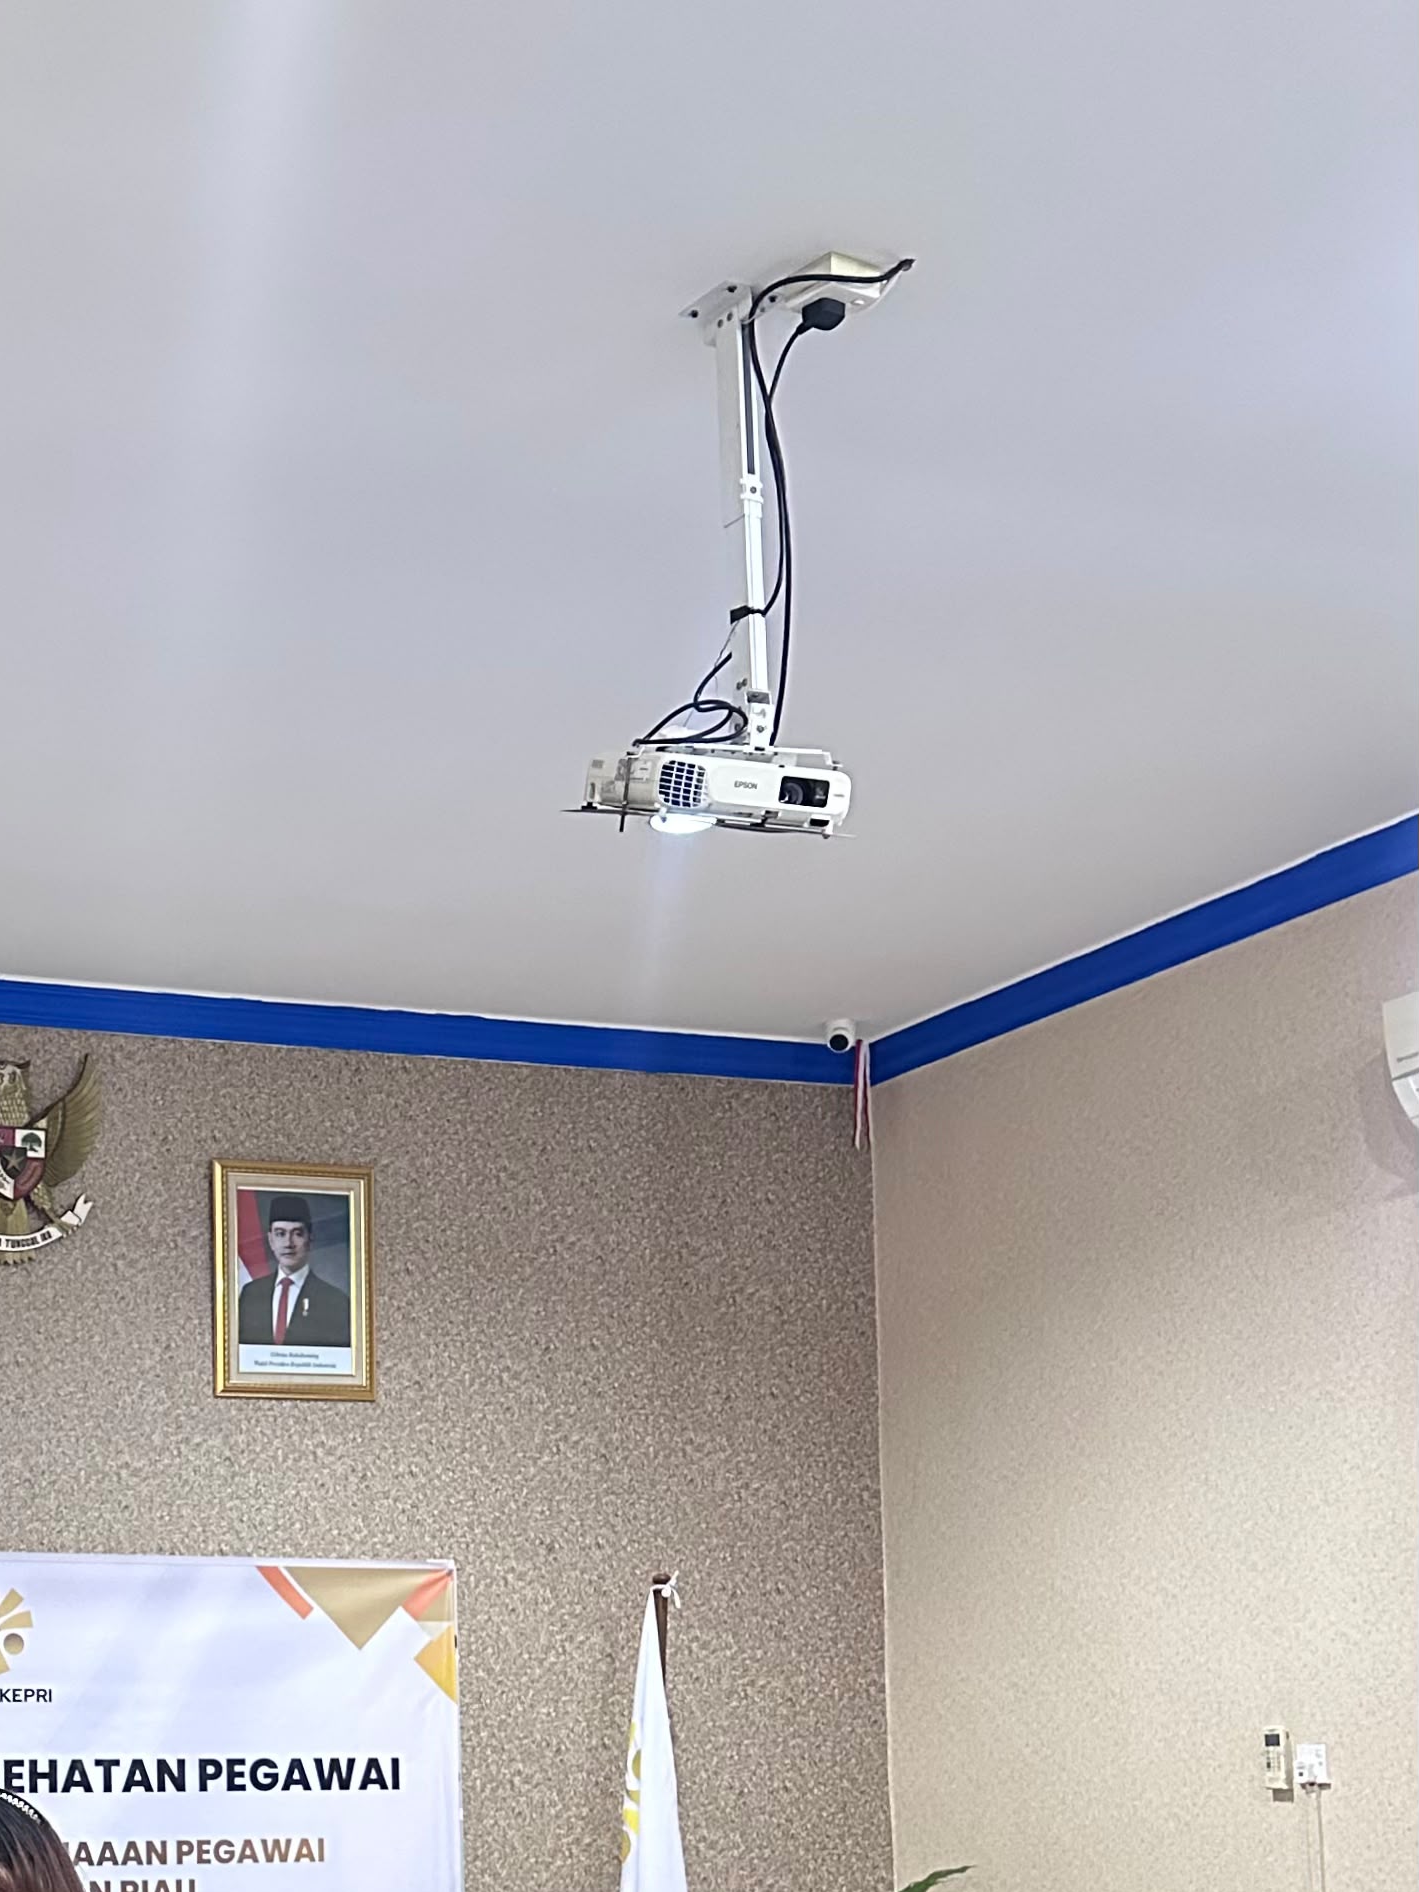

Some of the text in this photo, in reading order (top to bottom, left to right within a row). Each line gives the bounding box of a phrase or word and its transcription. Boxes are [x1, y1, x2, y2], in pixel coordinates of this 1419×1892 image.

[0, 1688, 52, 1703] KEPRI
[198, 1757, 400, 1792] PEGAWAI
[176, 1837, 325, 1865] PEGAWAI
